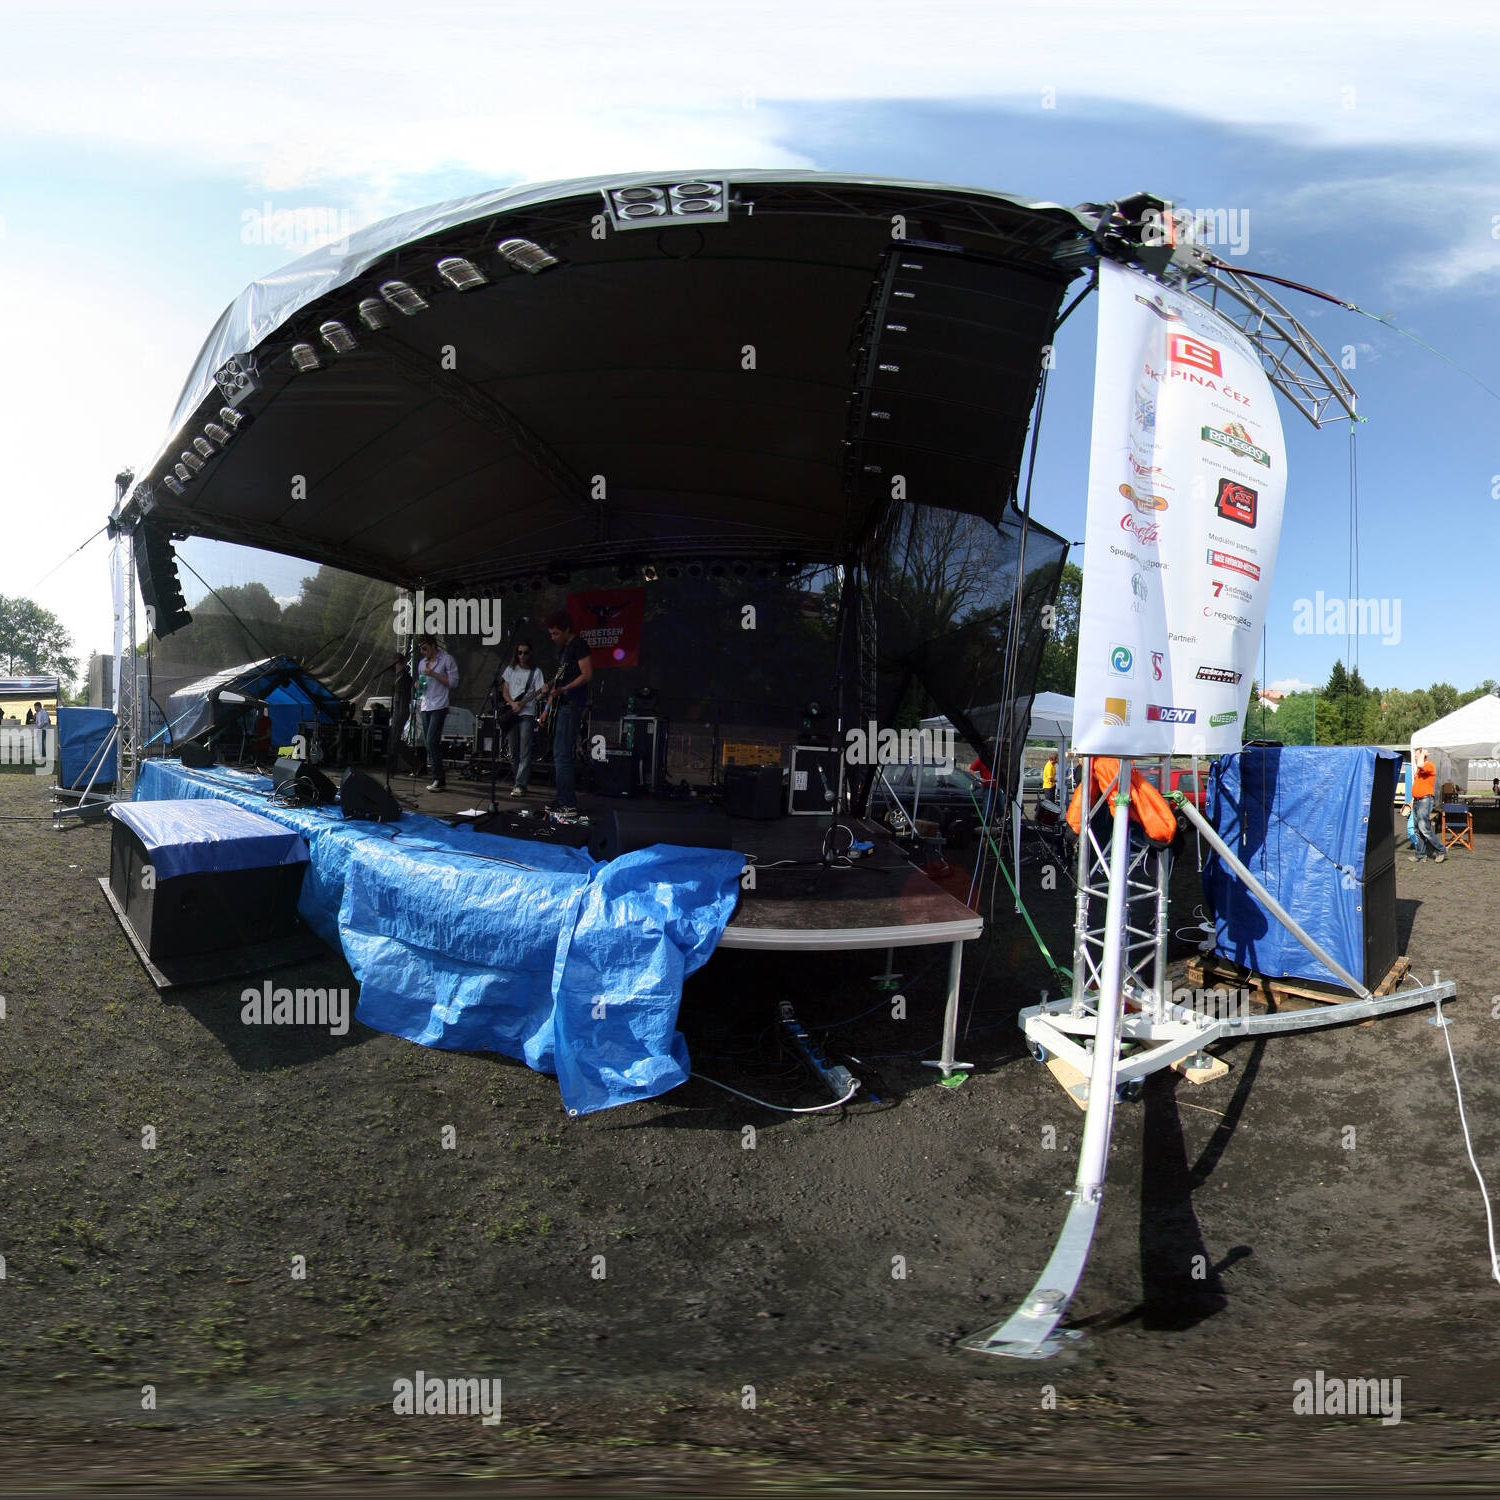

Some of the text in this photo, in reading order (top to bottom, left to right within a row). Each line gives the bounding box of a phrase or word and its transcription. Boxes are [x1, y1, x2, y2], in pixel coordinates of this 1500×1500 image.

[1222, 385, 1251, 407] ČEZ
[1209, 430, 1263, 460] RADEGAST
[1212, 581, 1224, 598] 7
